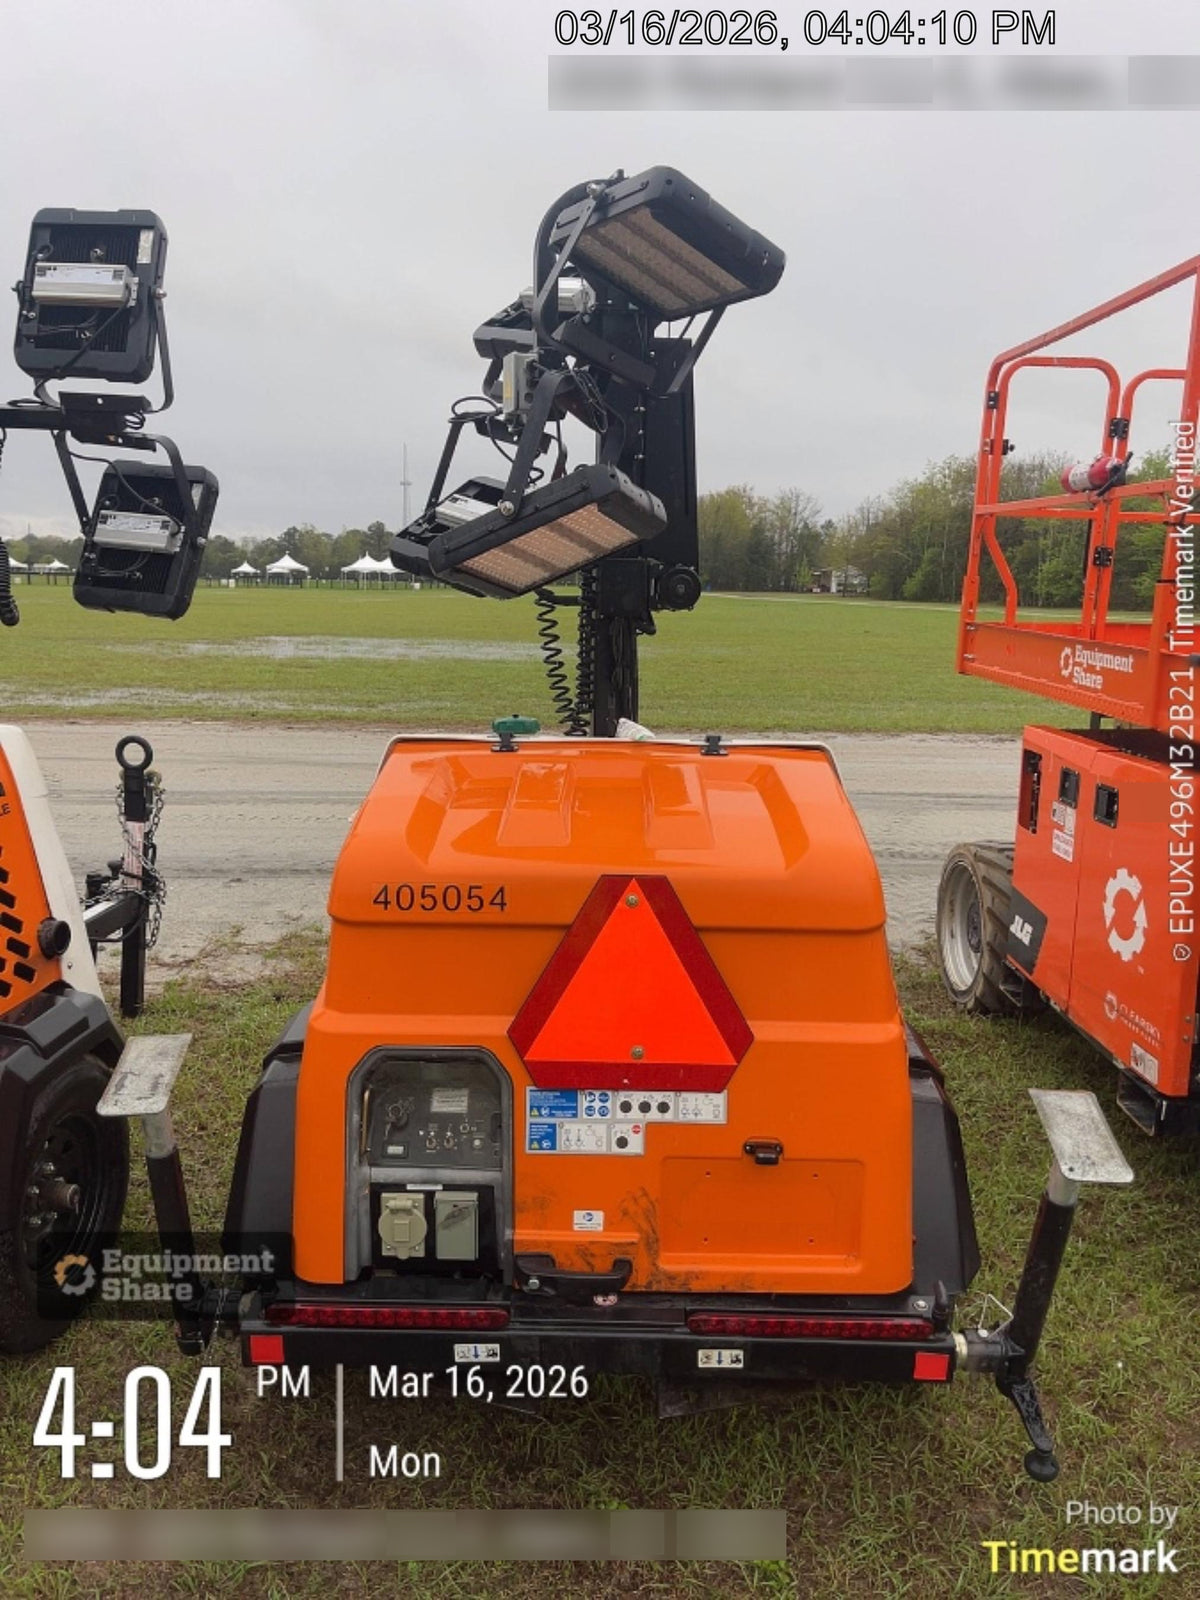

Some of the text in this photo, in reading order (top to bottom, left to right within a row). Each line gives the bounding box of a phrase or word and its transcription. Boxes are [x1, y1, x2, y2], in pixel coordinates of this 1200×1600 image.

[1075, 645, 1133, 673] Equipment
[1073, 666, 1103, 689] Share
[373, 884, 507, 911] 405054
[1010, 914, 1033, 946] JLG
